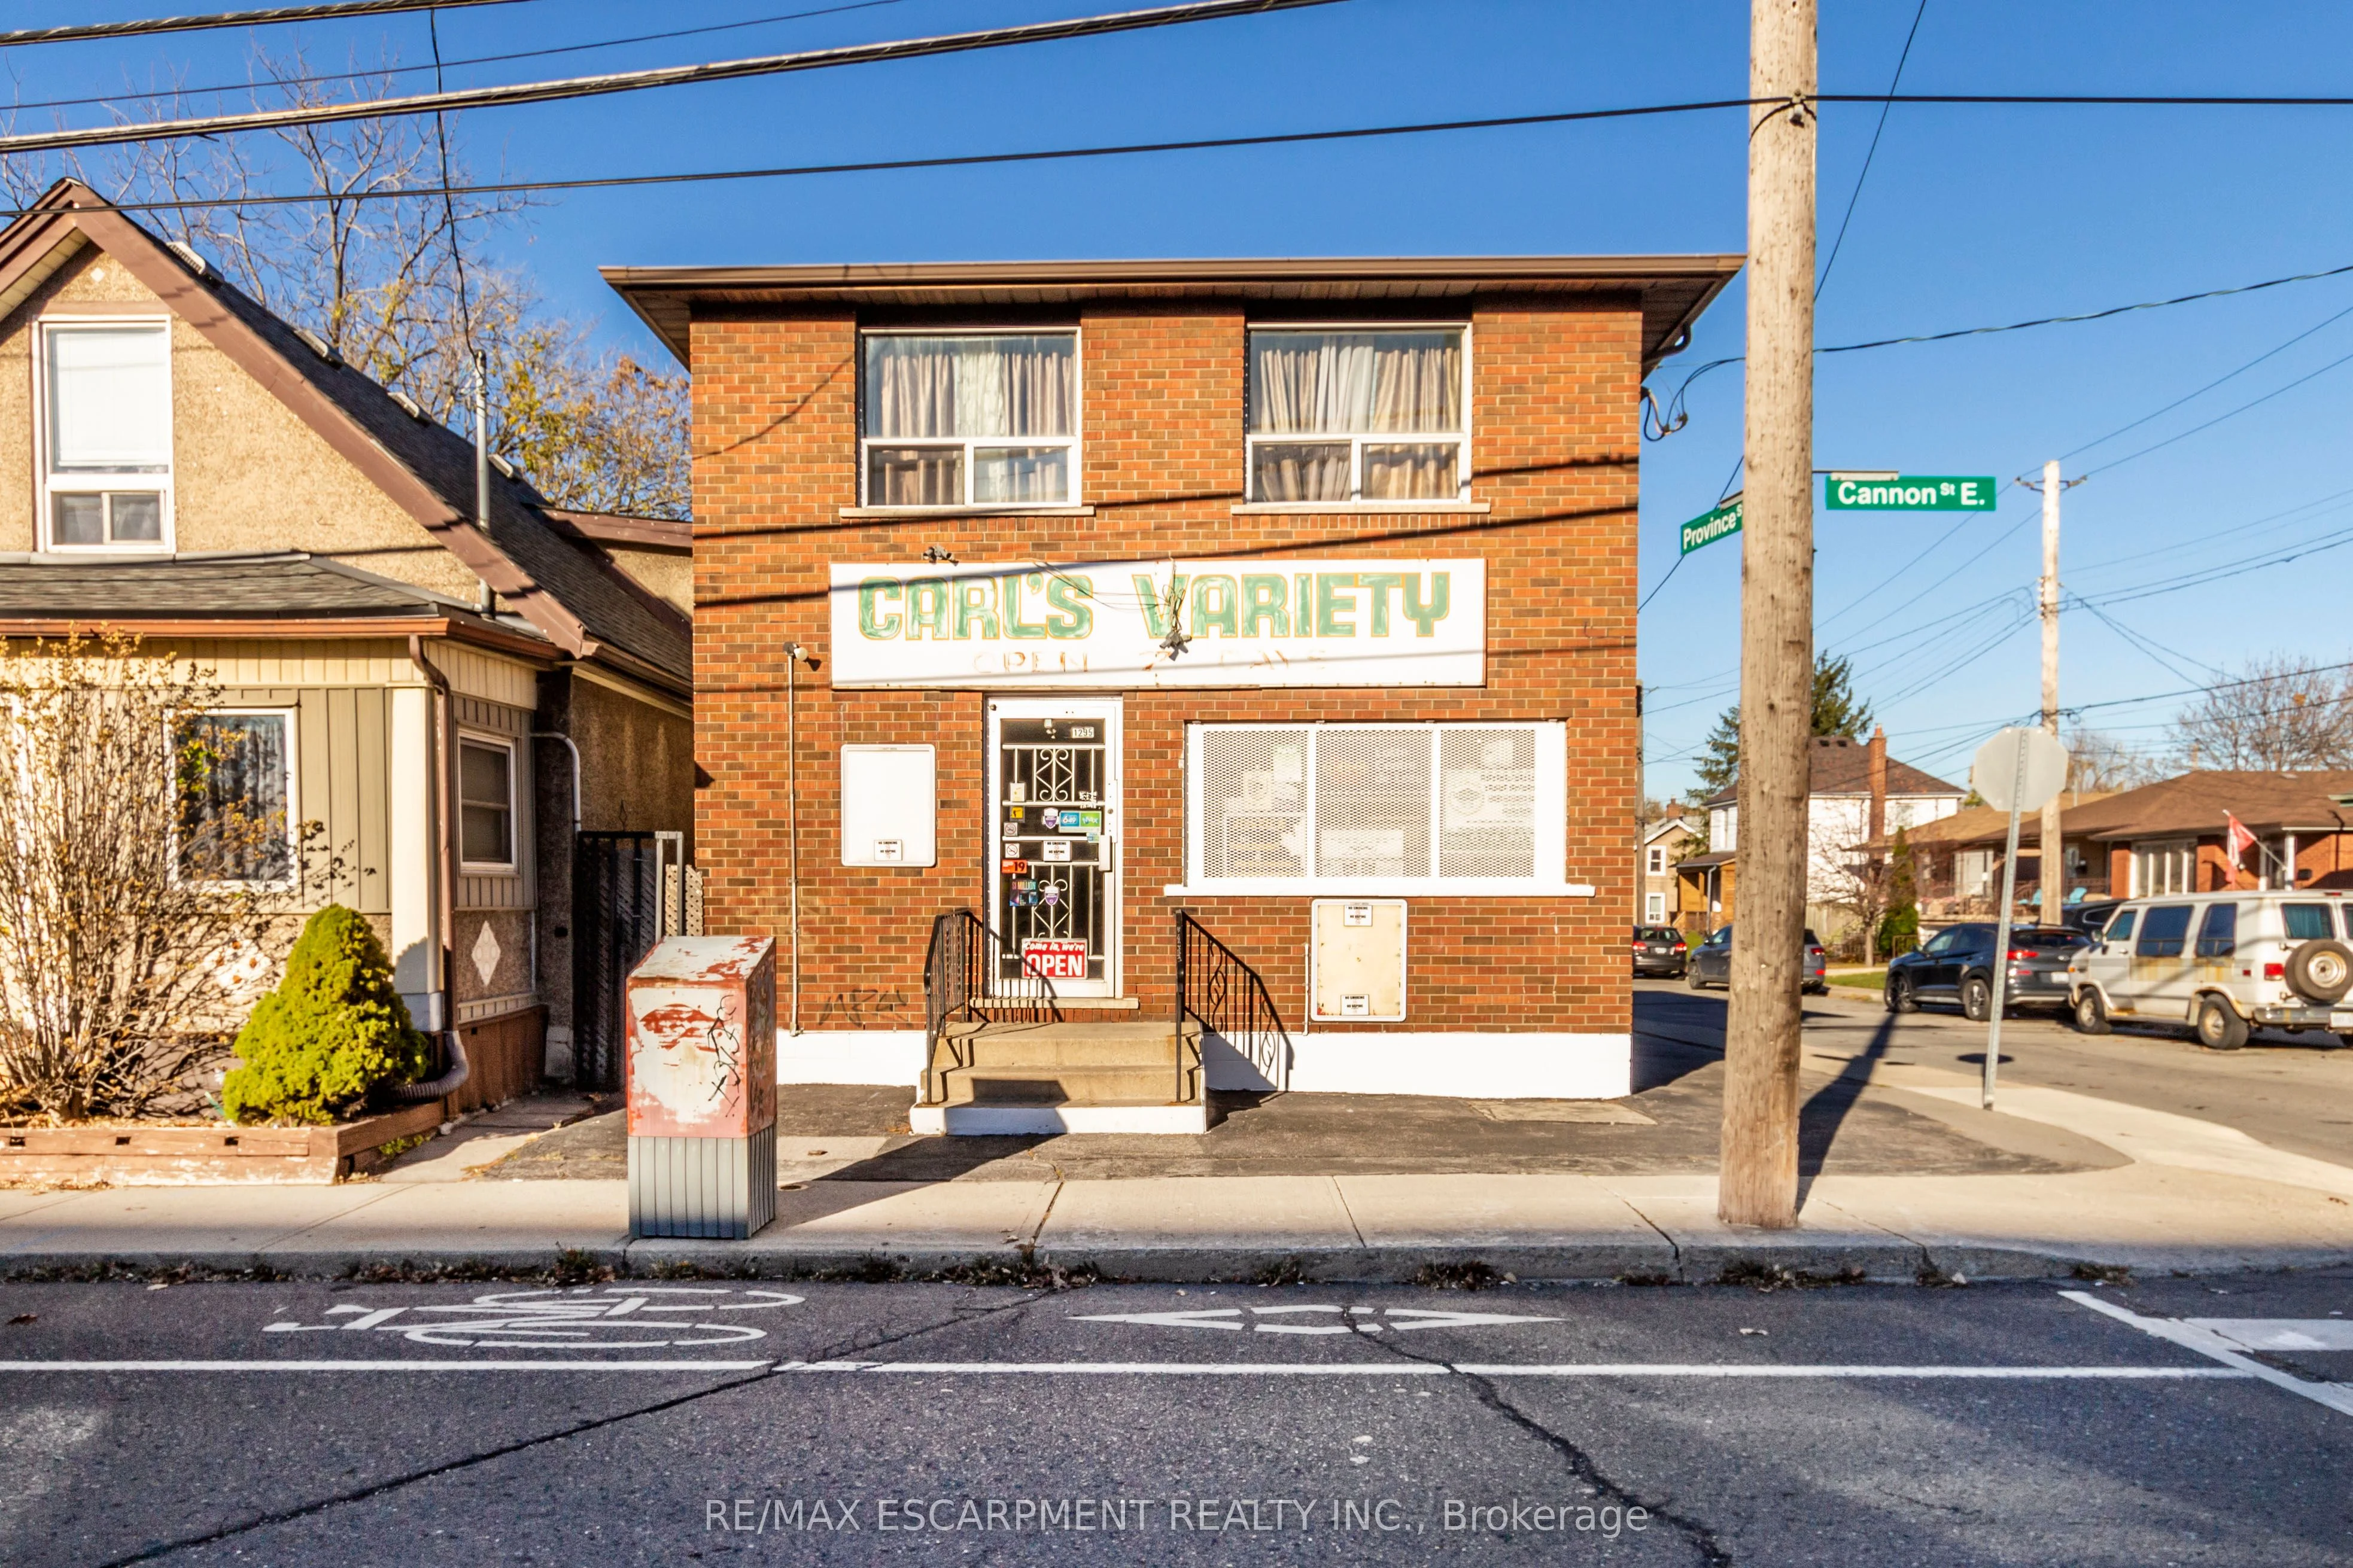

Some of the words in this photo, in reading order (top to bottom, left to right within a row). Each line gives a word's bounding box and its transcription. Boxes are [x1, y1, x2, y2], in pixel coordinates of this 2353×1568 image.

[1838, 481, 1937, 505] Cannon
[1940, 482, 1956, 496] St
[1960, 482, 1986, 506] E.
[1683, 511, 1737, 550] Province
[1736, 504, 1743, 517] S
[858, 572, 1093, 641] CARL'S
[1132, 572, 1451, 639] VARIETY
[1075, 728, 1093, 737] 1295
[1014, 861, 1025, 872] 19
[1025, 941, 1048, 951] Come
[1062, 942, 1085, 952] we're
[1026, 954, 1083, 977] OPEN
